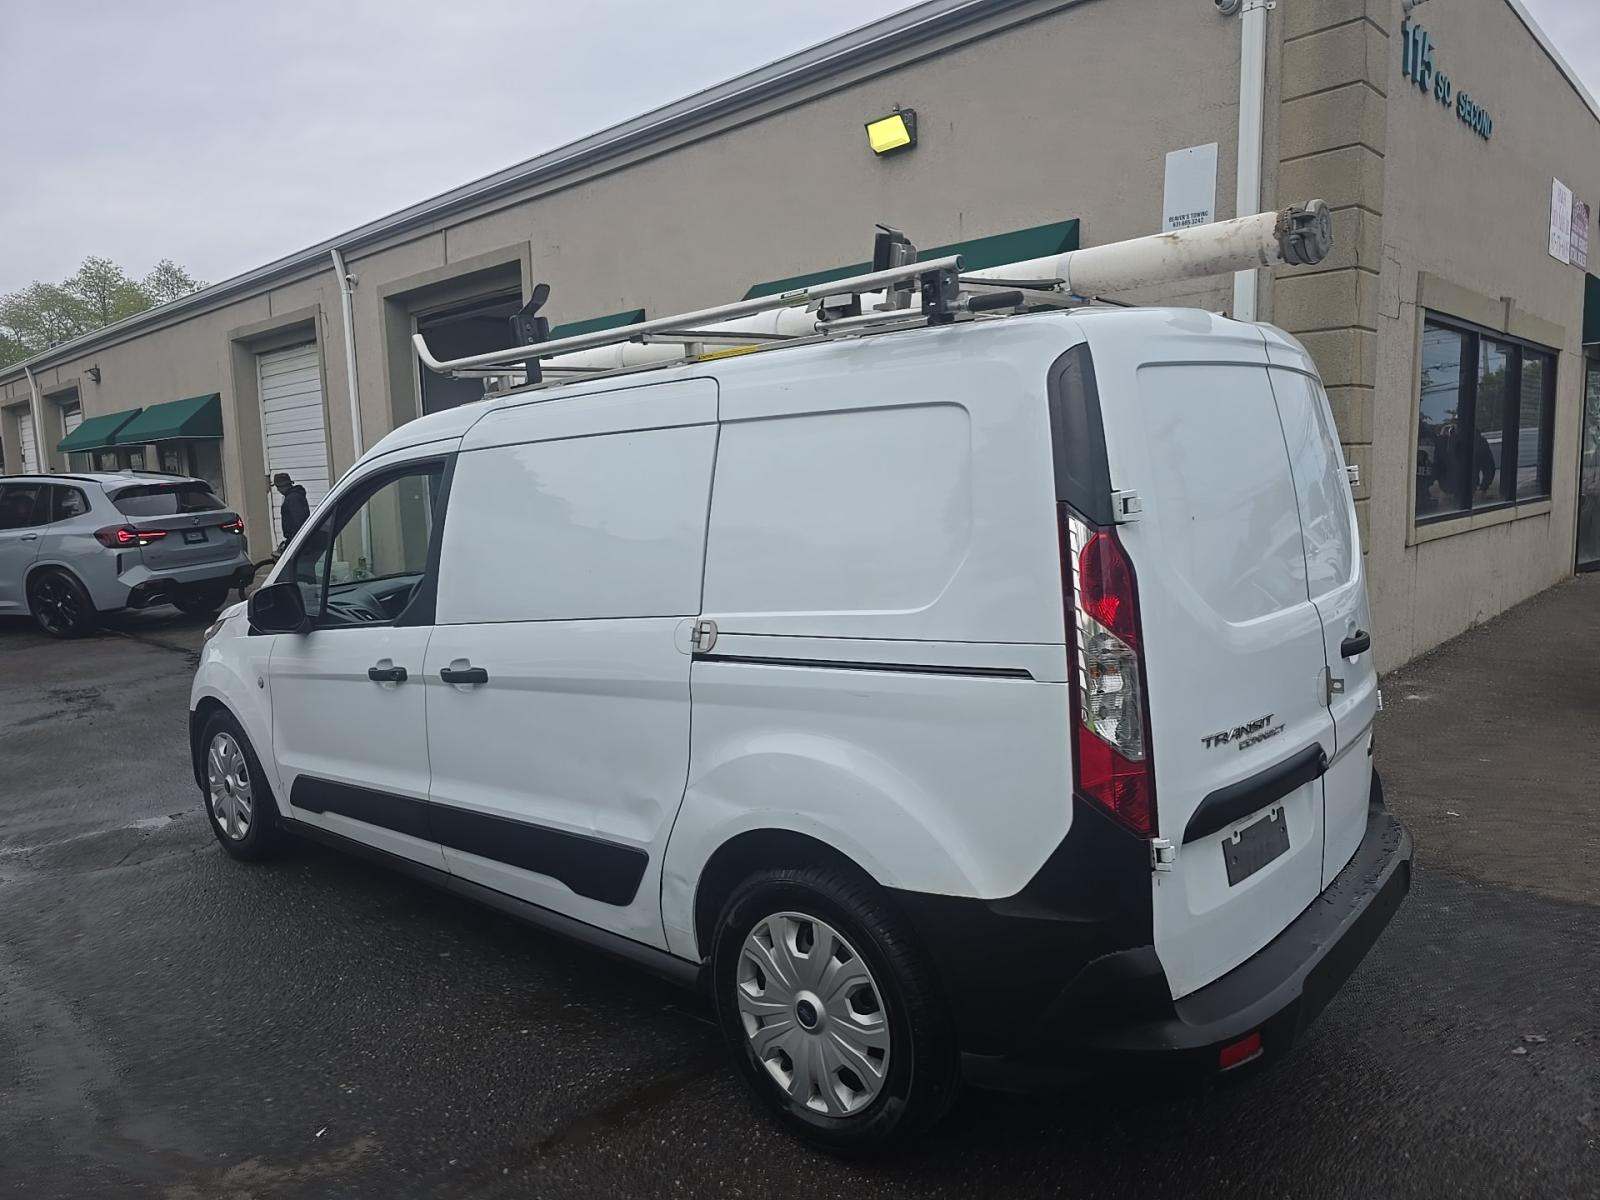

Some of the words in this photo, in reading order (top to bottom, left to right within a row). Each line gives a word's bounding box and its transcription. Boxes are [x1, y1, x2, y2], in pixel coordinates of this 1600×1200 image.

[1401, 16, 1434, 93] 115
[1456, 91, 1493, 139] SECOND
[1201, 713, 1275, 749] TRANSIT
[1239, 723, 1286, 750] CONNECT
